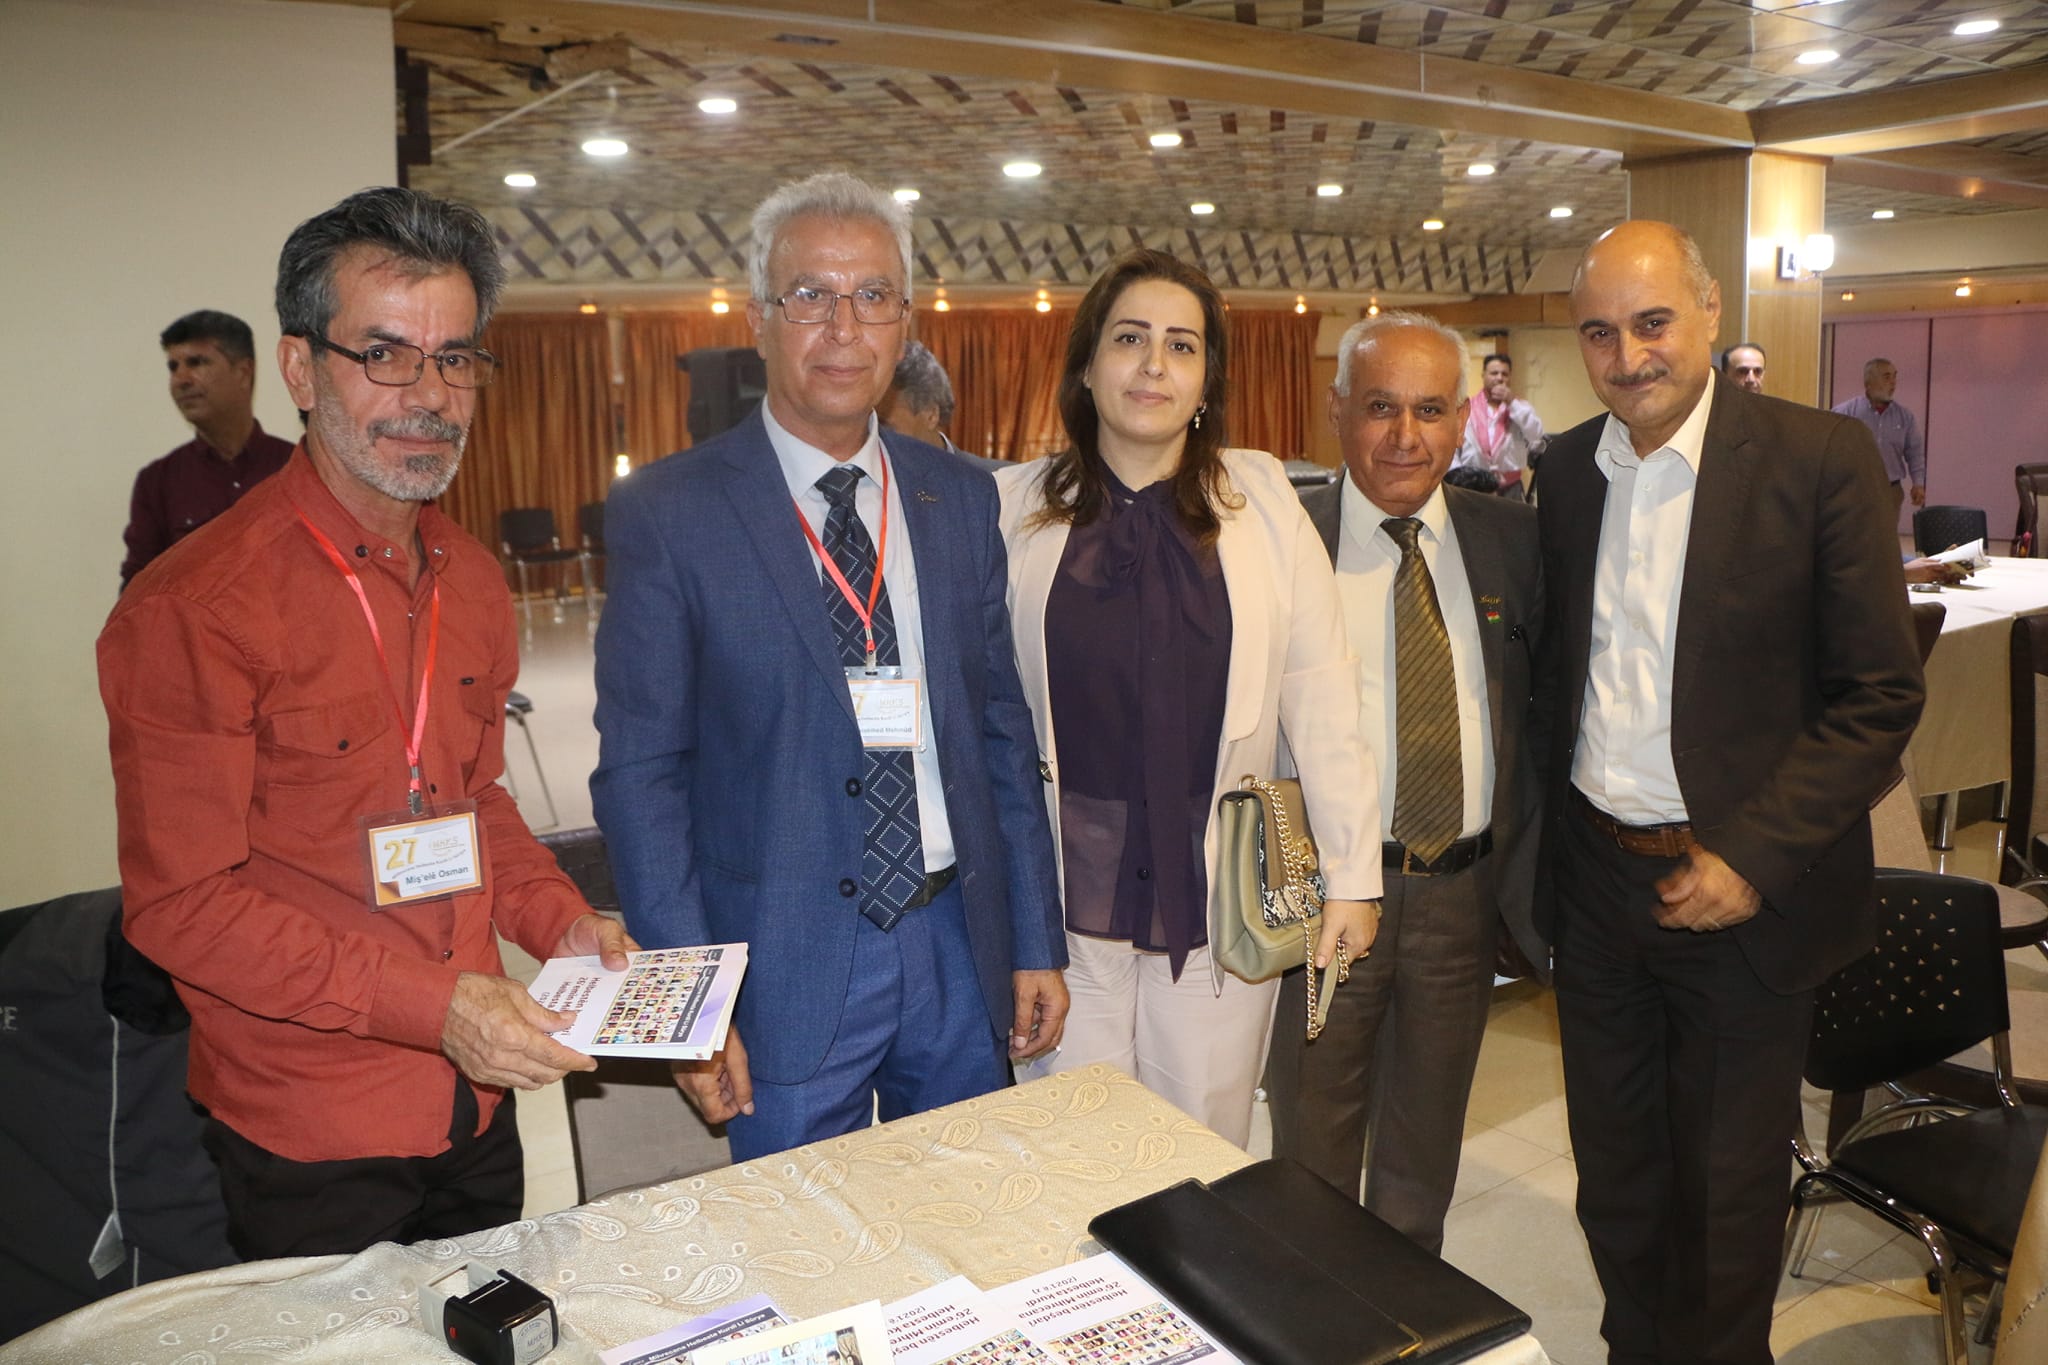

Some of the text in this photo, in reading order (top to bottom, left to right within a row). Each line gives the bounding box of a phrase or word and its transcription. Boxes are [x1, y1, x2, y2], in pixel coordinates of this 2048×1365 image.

[384, 838, 417, 871] 27
[438, 866, 469, 878] Osman
[1055, 1276, 1105, 1299] Helbesta
[1018, 1296, 1076, 1319] Mihrecana
[1071, 1288, 1128, 1313] Helbestên
[902, 1303, 955, 1330] Helbesta
[919, 1315, 980, 1346] Helbestên
